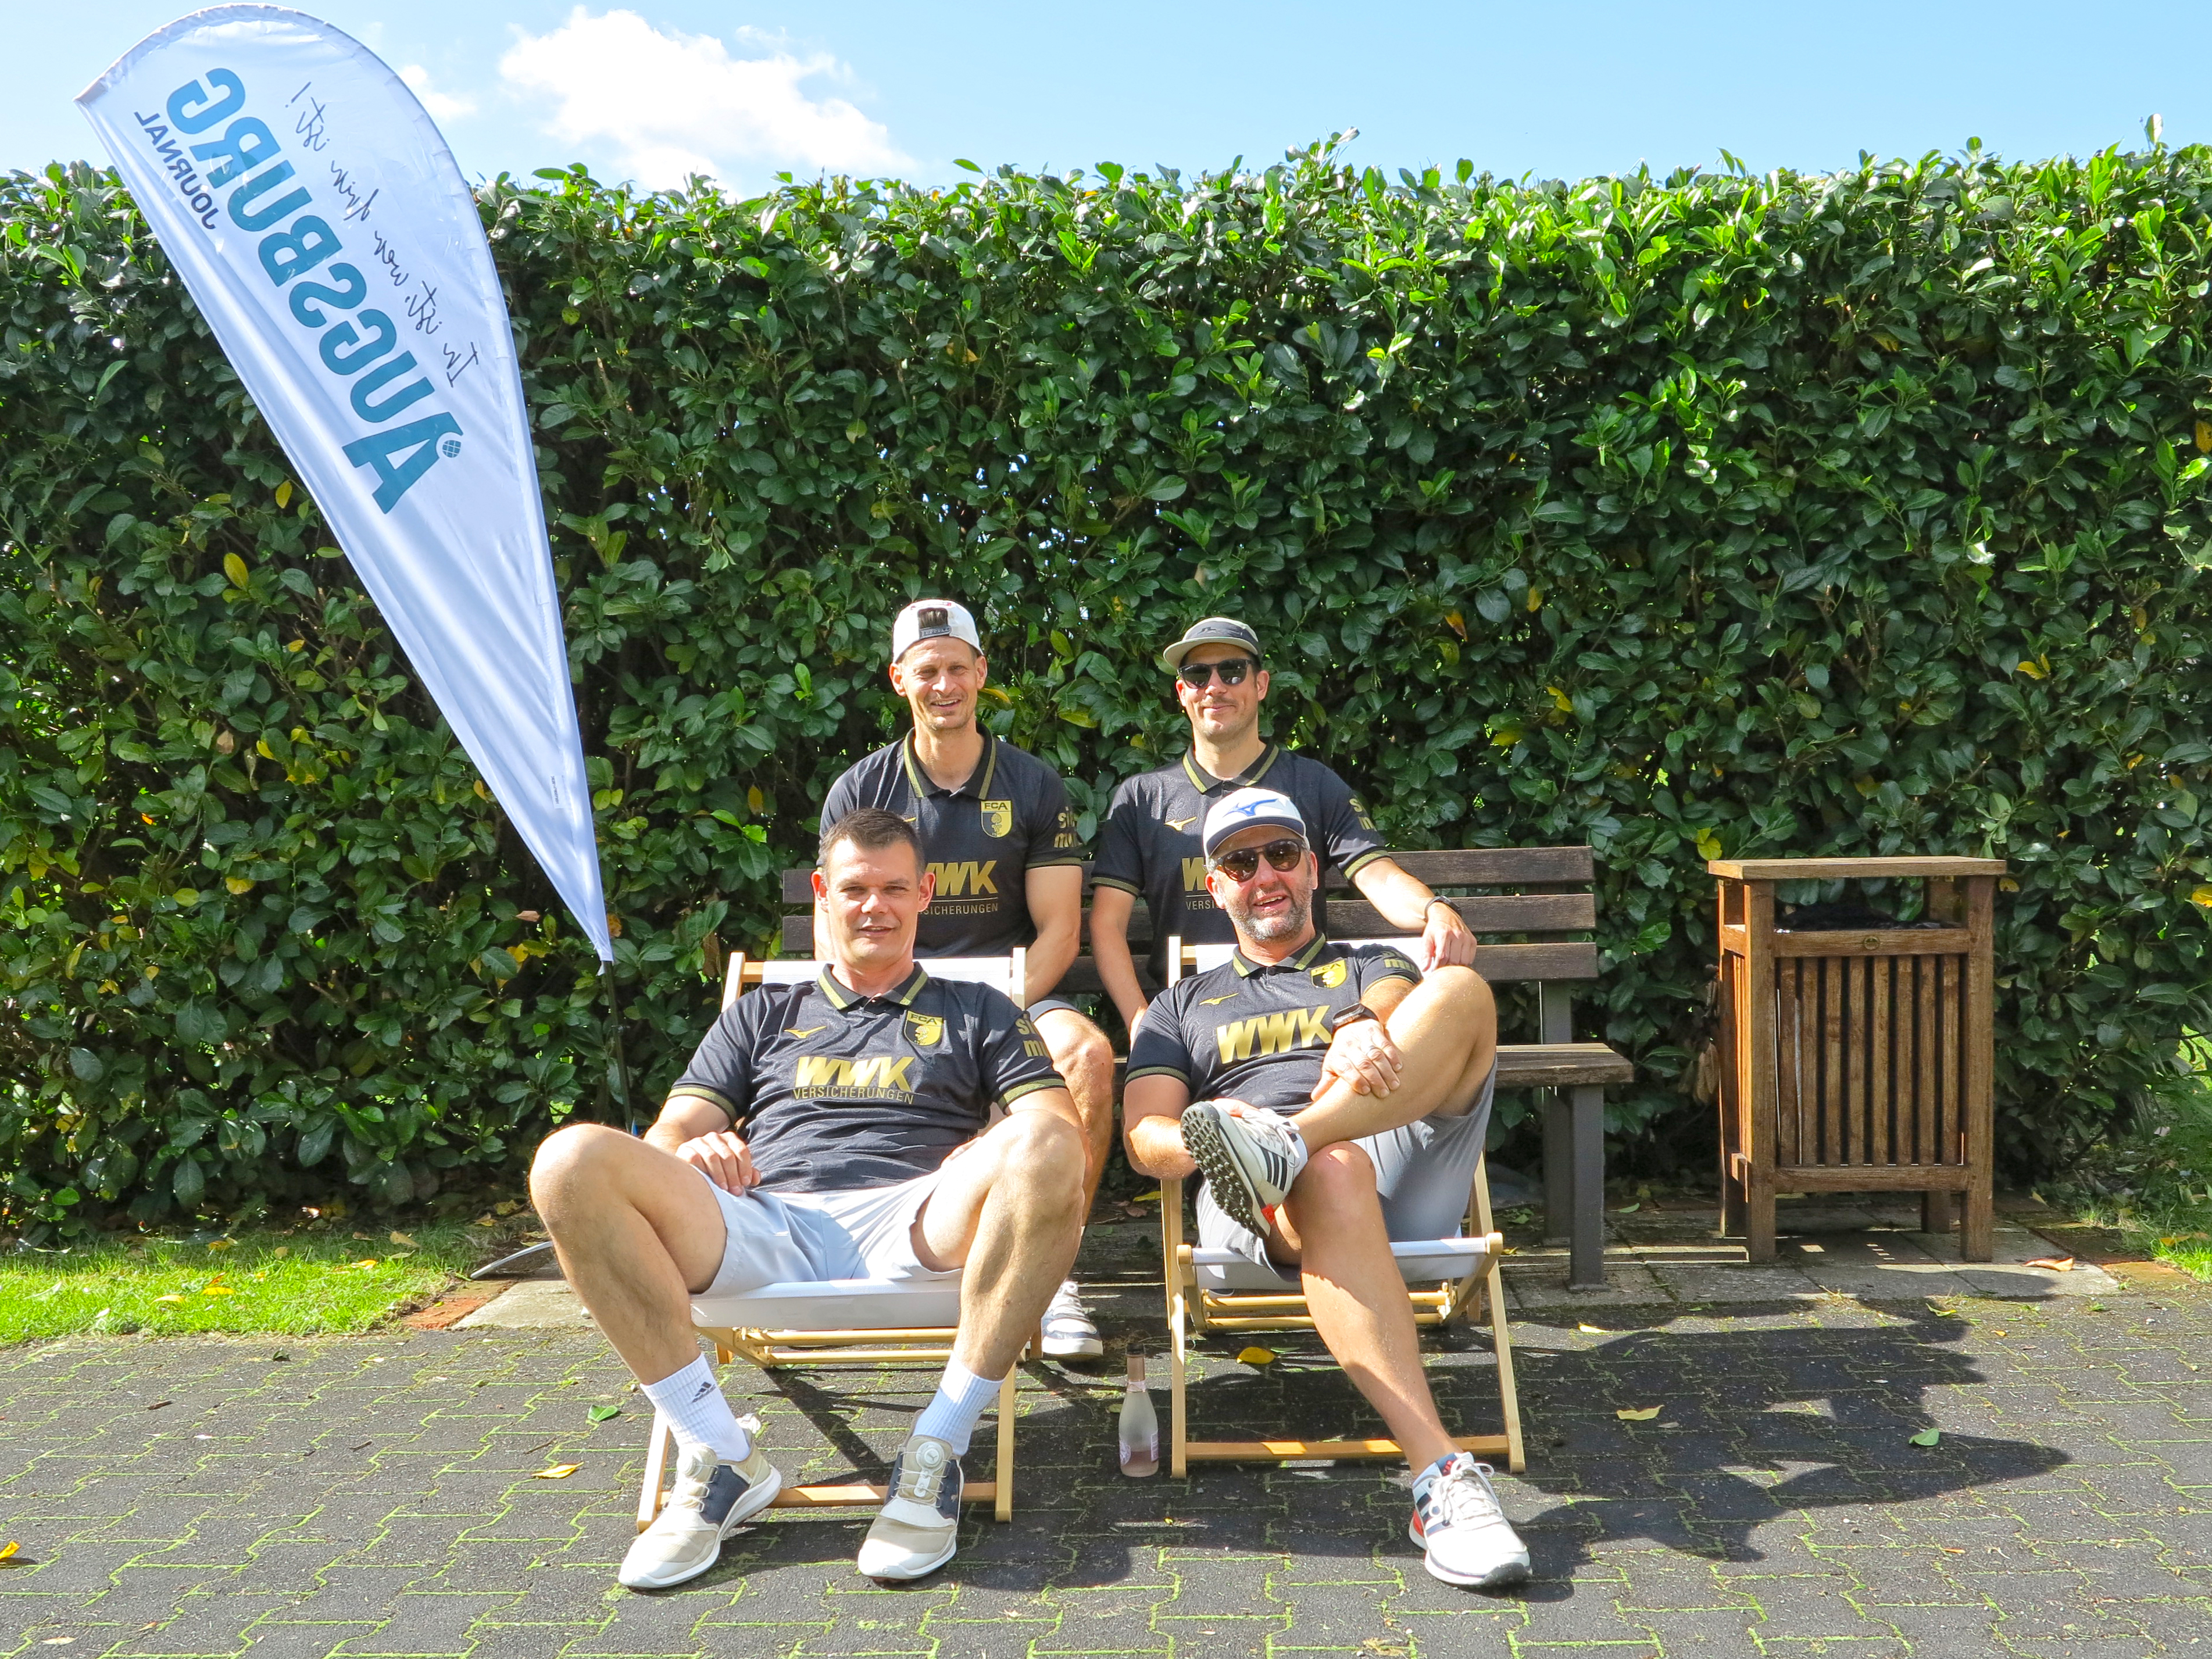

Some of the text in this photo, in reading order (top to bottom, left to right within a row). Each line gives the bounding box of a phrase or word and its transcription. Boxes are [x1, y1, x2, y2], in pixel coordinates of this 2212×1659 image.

[984, 802, 1008, 810] FCA
[925, 860, 998, 896] WK
[920, 903, 998, 916] SICHERUNGEN
[911, 1014, 937, 1025] FCA
[1217, 1005, 1332, 1064] WWK
[795, 1056, 915, 1092] WWK
[793, 1086, 914, 1104] VERSICHERUNGEN
